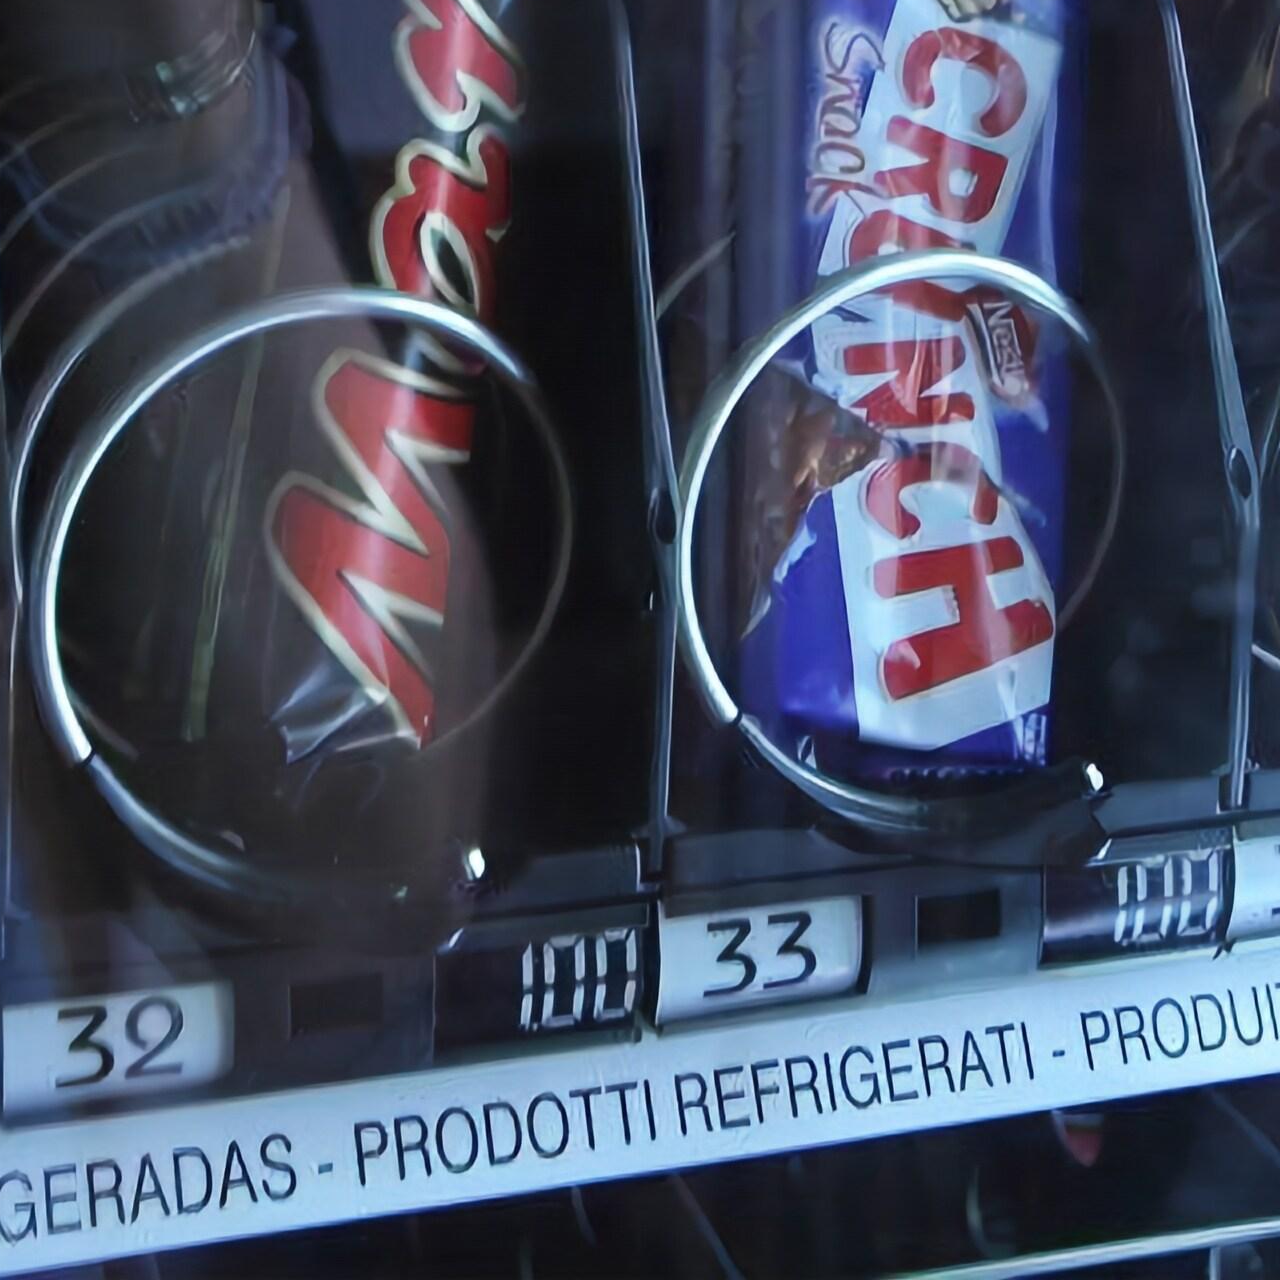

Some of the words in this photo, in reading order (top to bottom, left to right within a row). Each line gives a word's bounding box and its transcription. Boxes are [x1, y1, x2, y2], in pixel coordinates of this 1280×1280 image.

[806, 22, 886, 219] Snack
[842, 26, 1054, 702] CRUNCH
[703, 910, 818, 997] 33
[55, 994, 184, 1089] 32
[354, 1078, 657, 1186] PRODOTTI
[675, 1020, 1035, 1138] REFRIGERATI
